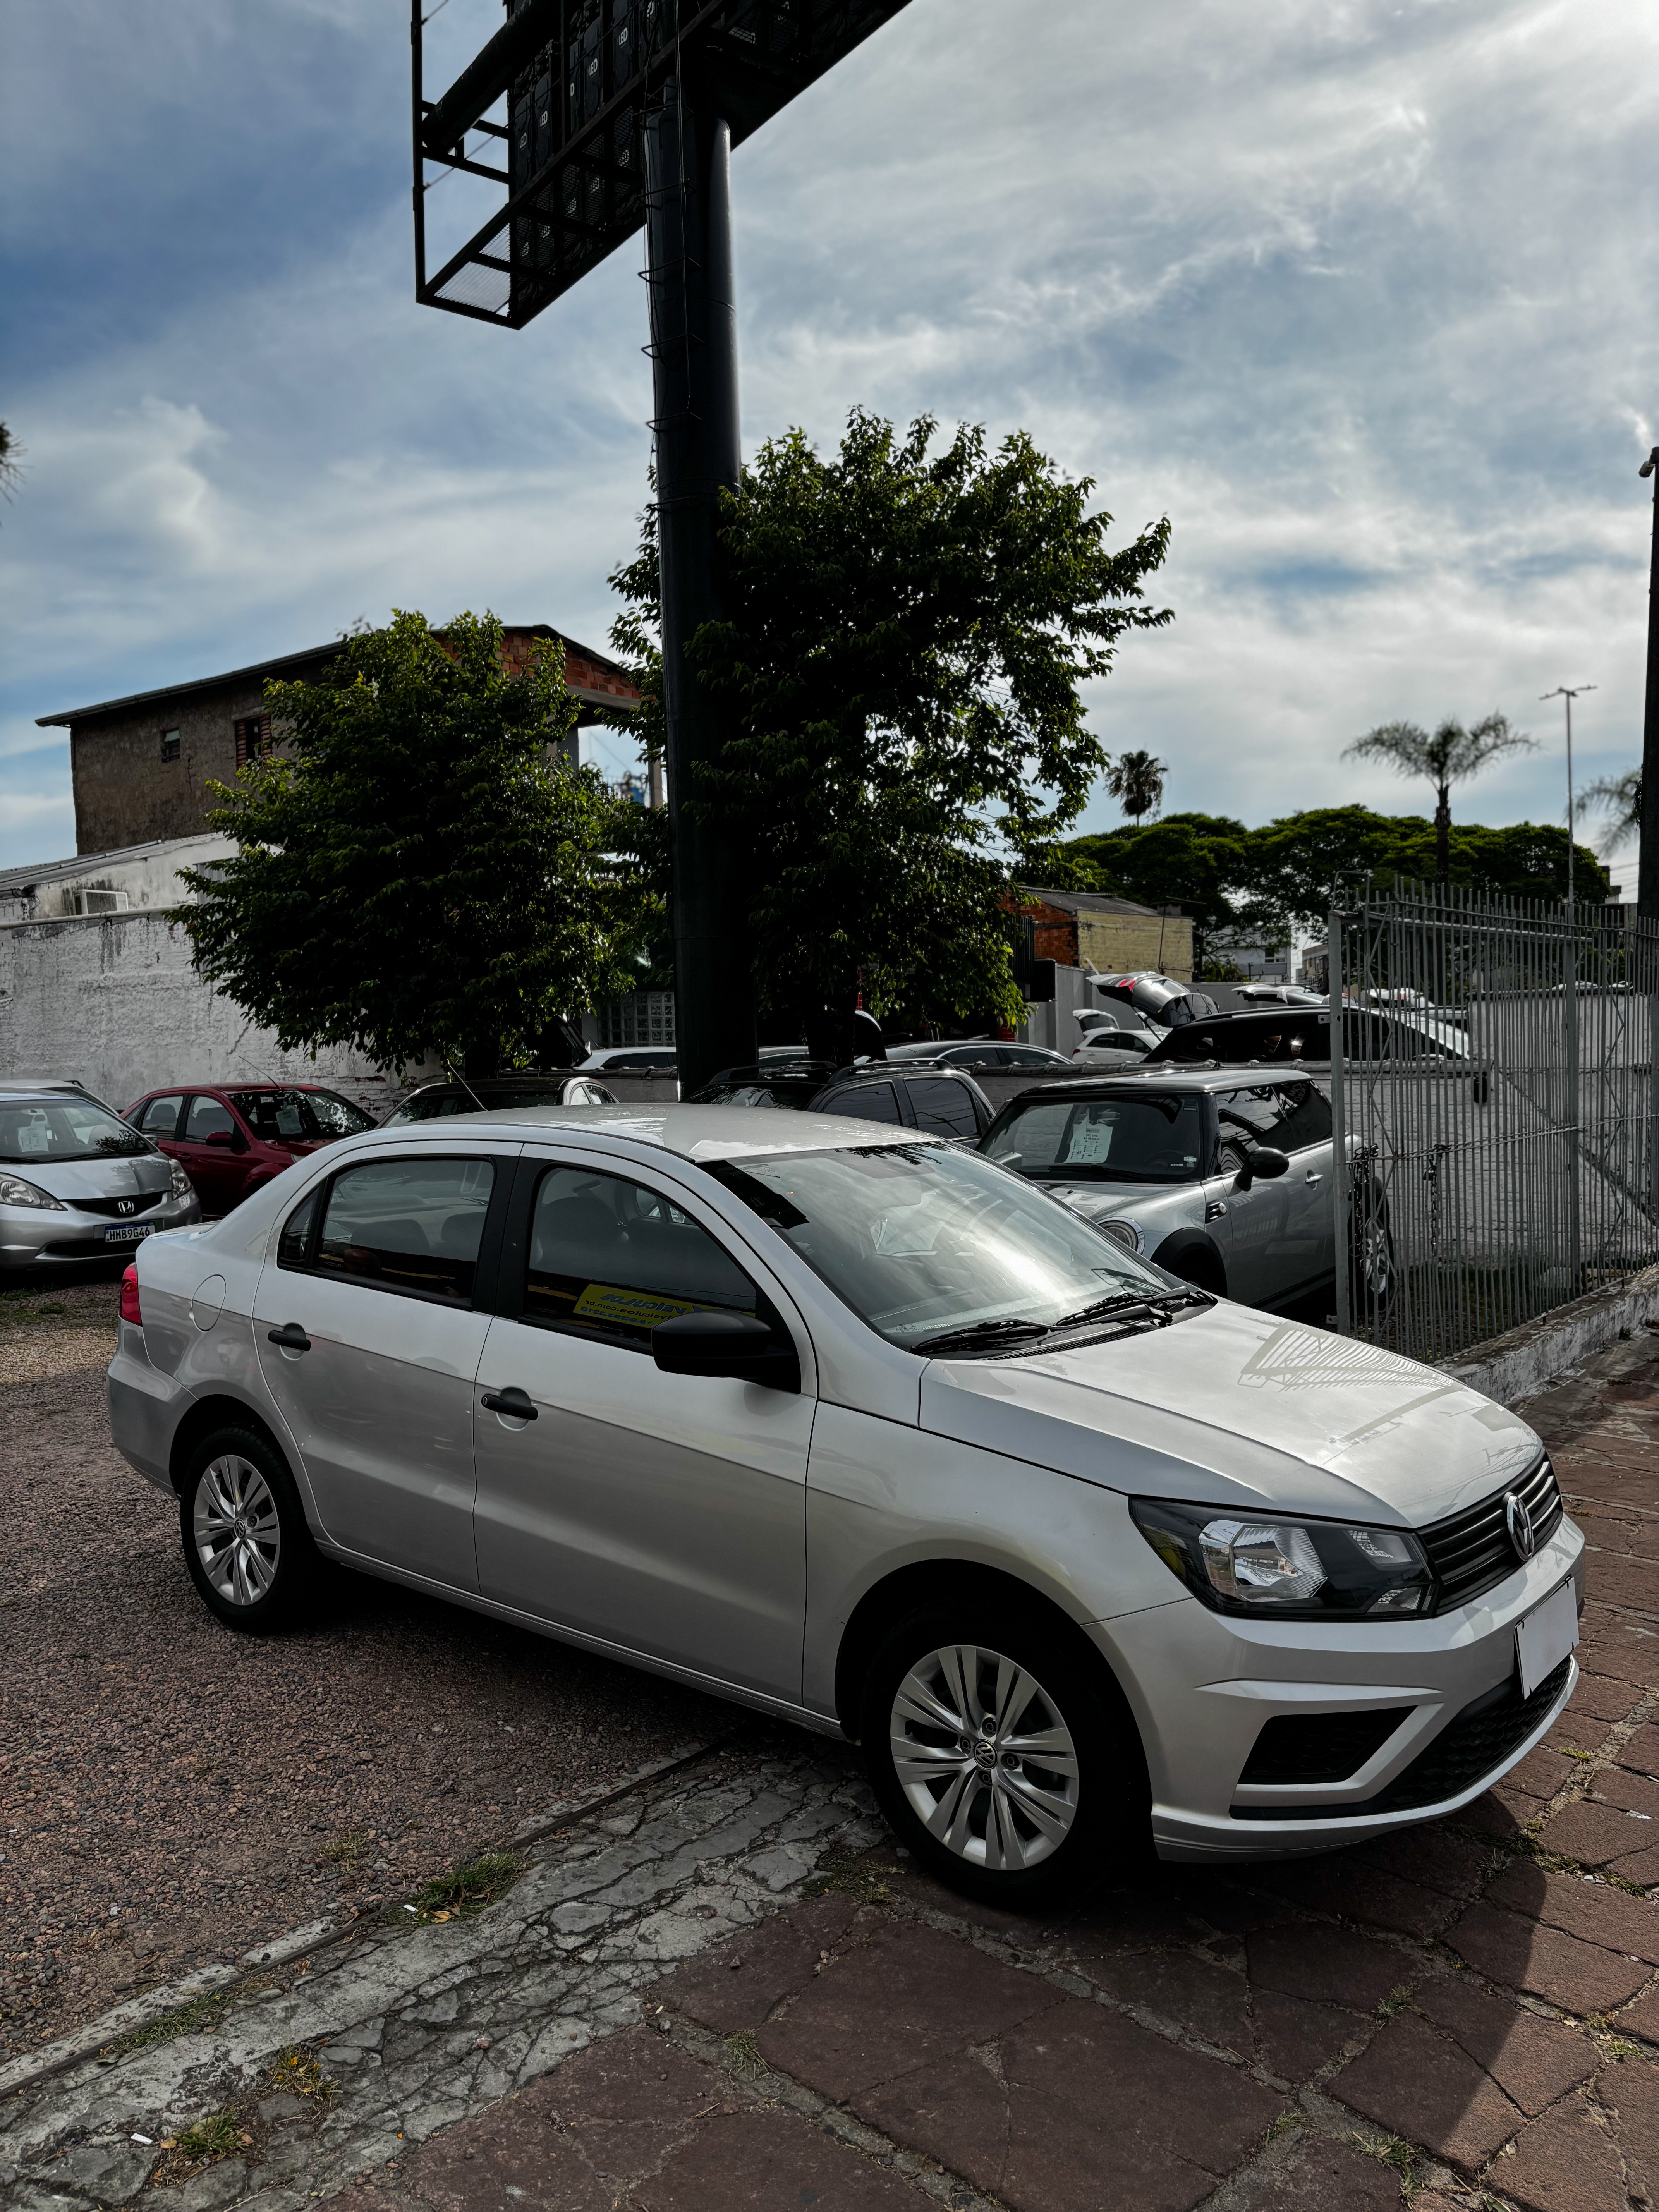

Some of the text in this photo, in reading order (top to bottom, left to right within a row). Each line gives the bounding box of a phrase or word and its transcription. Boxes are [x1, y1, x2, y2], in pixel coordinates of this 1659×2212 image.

[618, 27, 628, 46] LED
[589, 58, 598, 76] LED
[540, 110, 548, 127] LED
[110, 1227, 150, 1240] HMB9G46
